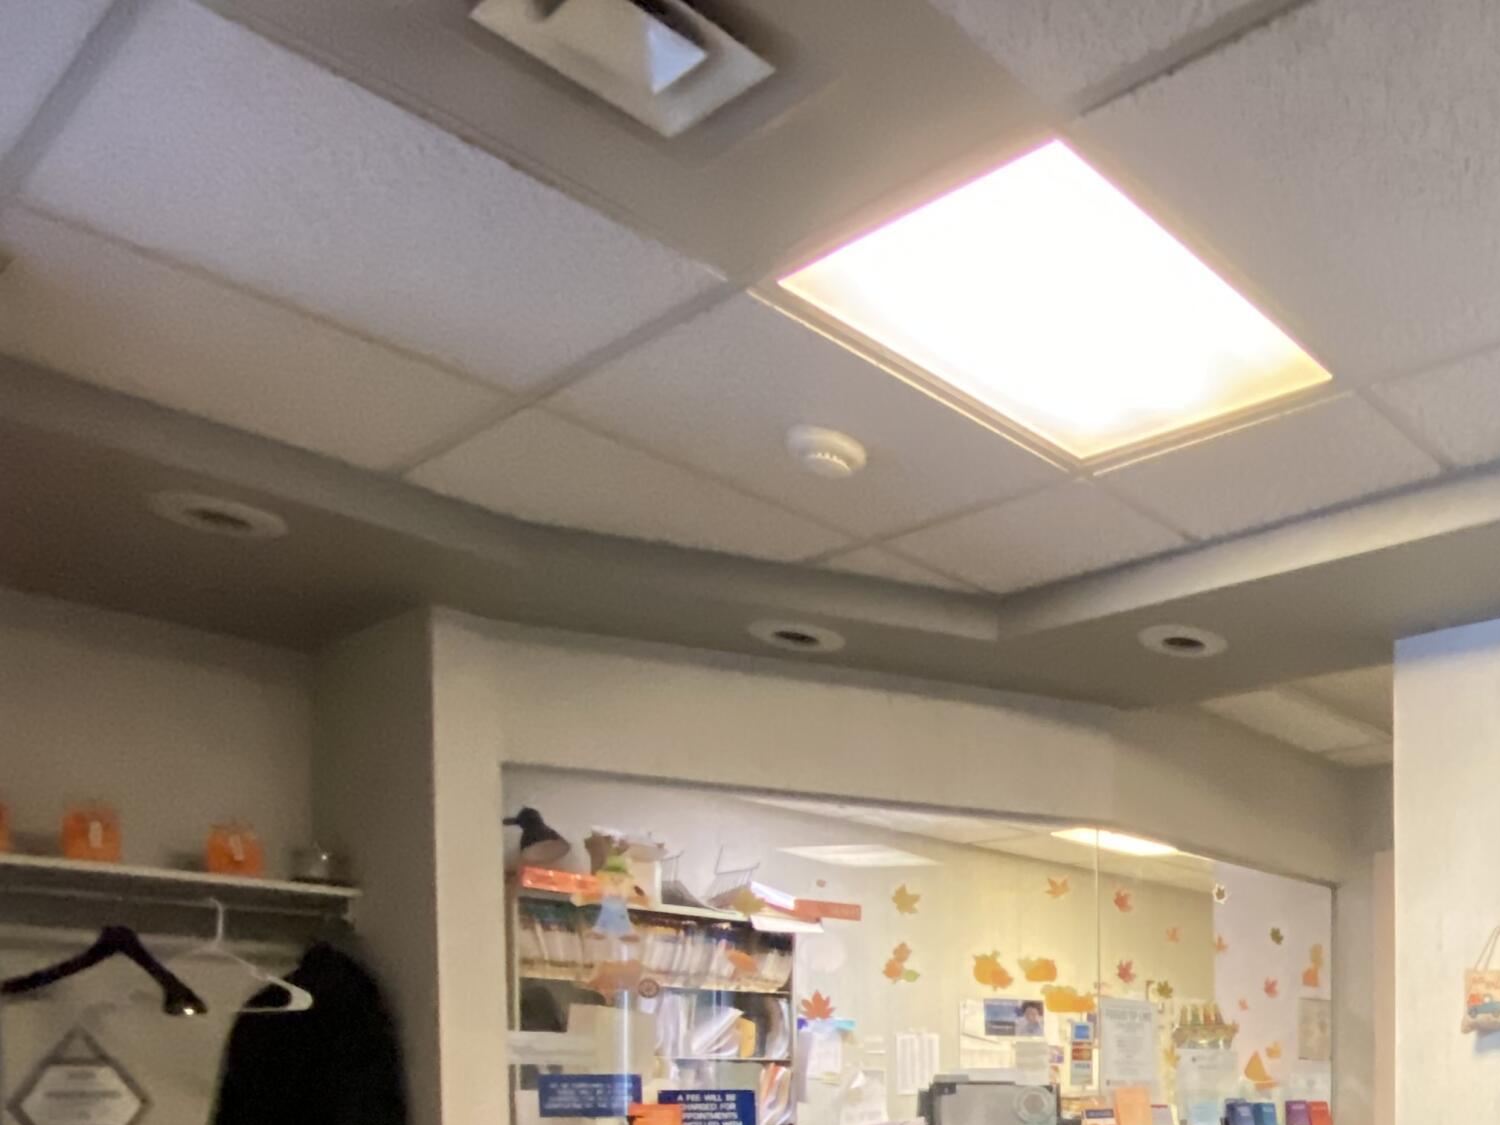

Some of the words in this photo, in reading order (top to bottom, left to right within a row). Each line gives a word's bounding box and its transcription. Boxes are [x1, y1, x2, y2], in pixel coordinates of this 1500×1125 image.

[686, 1093, 700, 1102] FEE
[704, 1093, 722, 1102] WILL
[682, 1102, 717, 1111] HARGED
[719, 1102, 737, 1111] FOR
